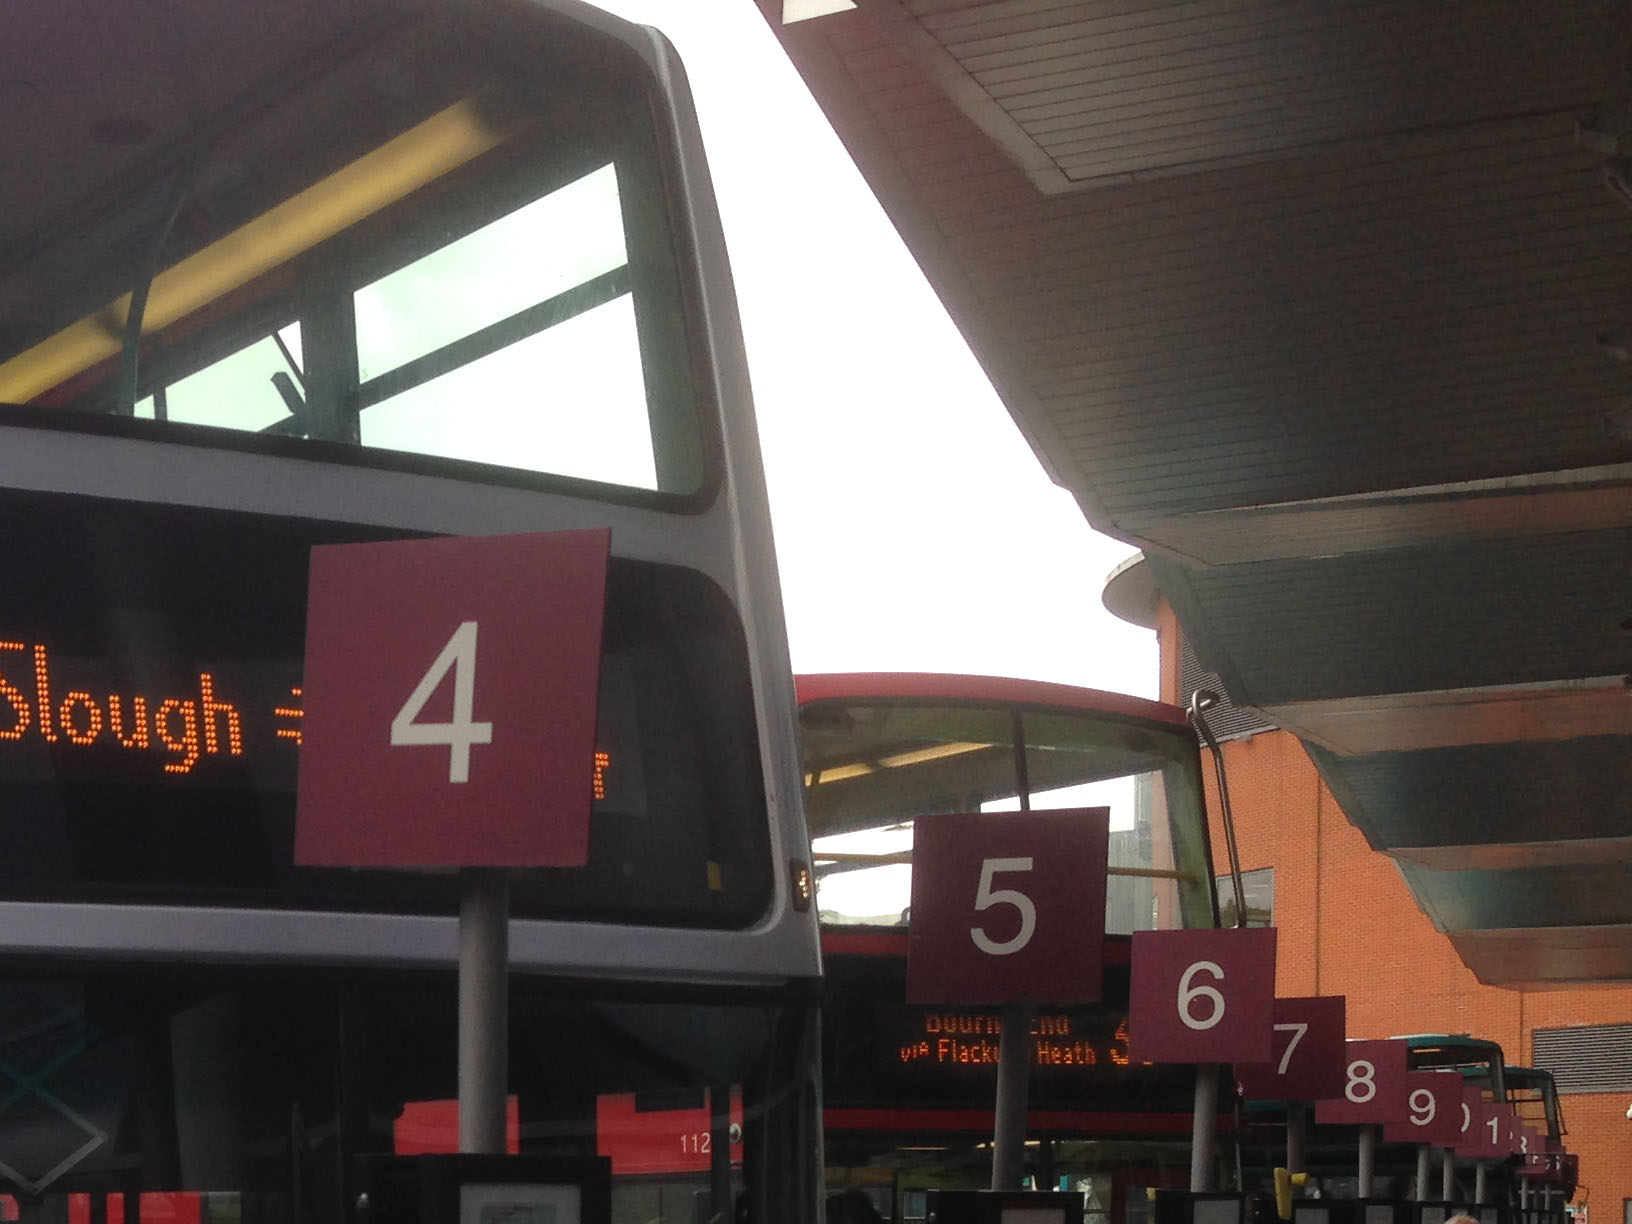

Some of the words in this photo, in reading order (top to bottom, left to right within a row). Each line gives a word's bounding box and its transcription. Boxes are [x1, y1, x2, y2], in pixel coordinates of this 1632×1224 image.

[390, 621, 493, 783] 4
[969, 857, 1037, 955] 5
[1177, 961, 1227, 1031] 6
[926, 1015, 1001, 1034] Bourn
[938, 1039, 1001, 1063] Flack
[1037, 1040, 1097, 1064] Heath
[1273, 1023, 1308, 1075] 7
[1345, 1060, 1376, 1103] 8
[1409, 1089, 1436, 1126] 9
[680, 1132, 711, 1153] 112
[1486, 1116, 1499, 1144] 1
